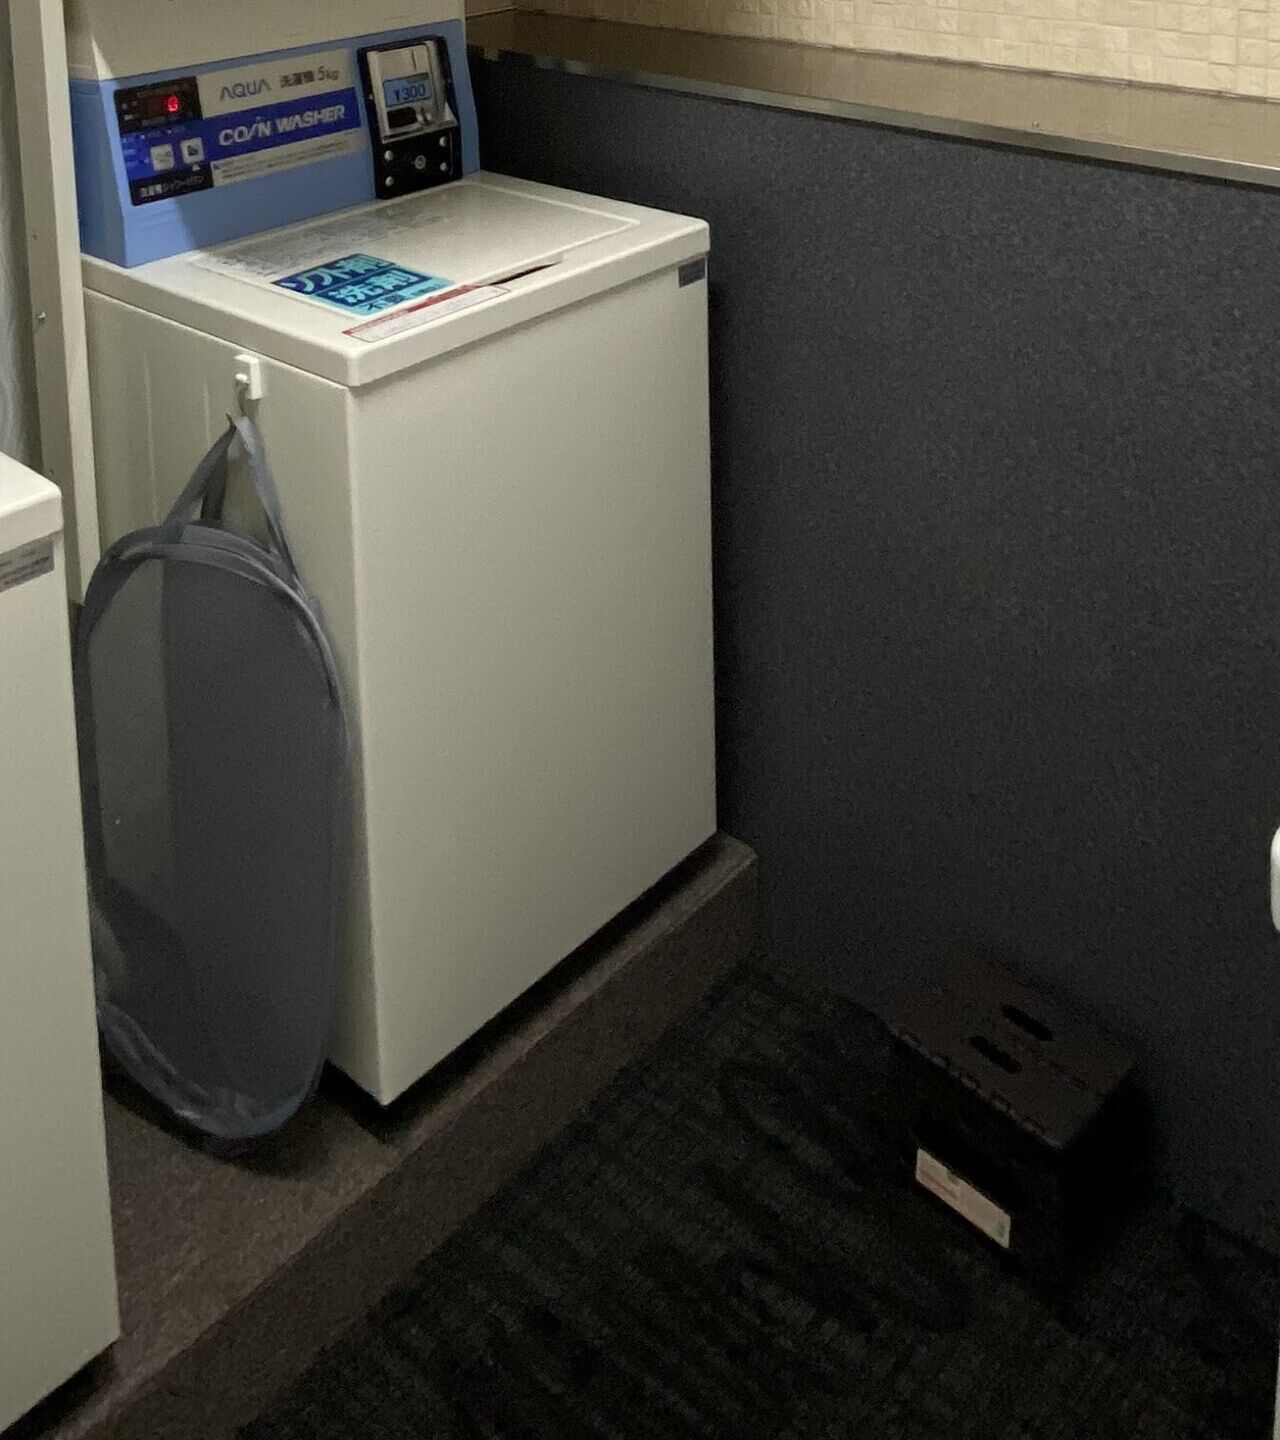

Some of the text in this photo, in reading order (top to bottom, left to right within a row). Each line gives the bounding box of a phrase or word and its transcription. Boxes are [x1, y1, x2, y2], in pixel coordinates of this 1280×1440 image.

[220, 79, 272, 101] AQUA
[275, 104, 346, 133] WASHER
[327, 269, 420, 305] 洗剤
